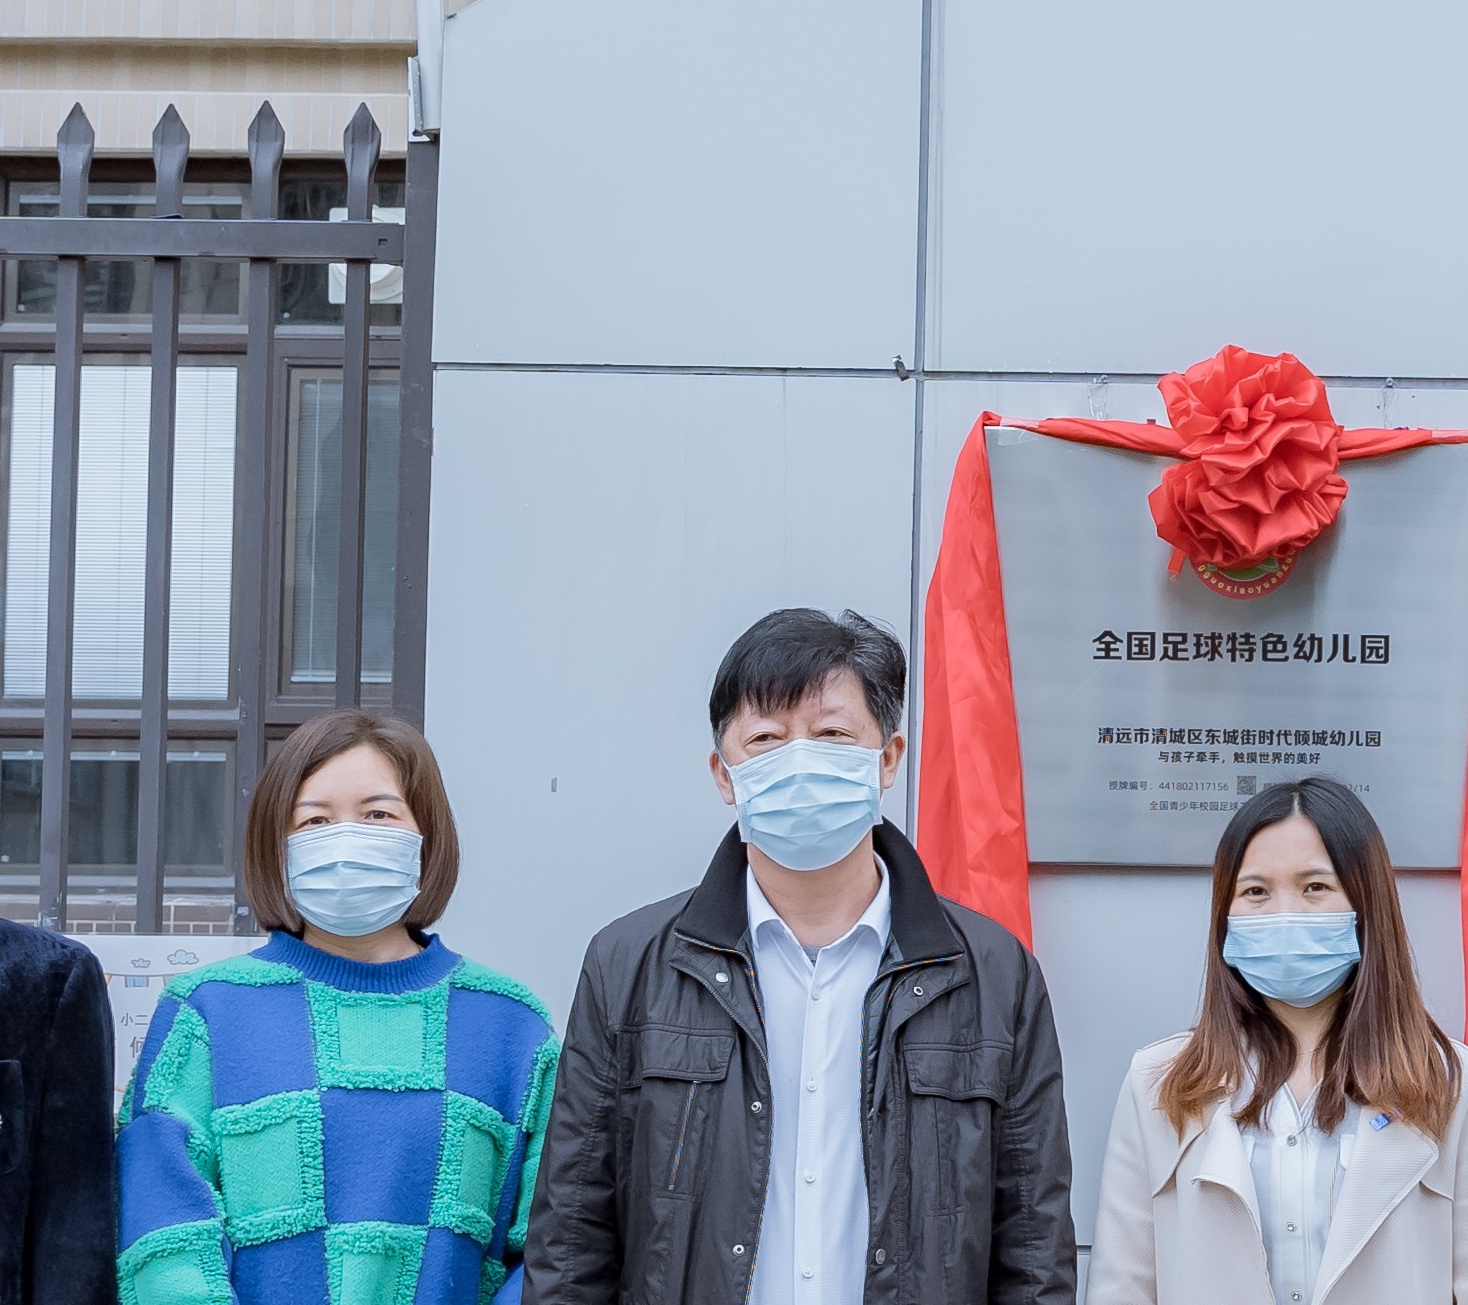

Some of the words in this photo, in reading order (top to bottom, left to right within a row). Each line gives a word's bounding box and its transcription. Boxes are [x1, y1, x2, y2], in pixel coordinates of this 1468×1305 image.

[1091, 630, 1391, 665] 全国足球特色幼儿园
[1097, 726, 1382, 748] 清远市清城区东城街时代倾城幼儿园
[1157, 750, 1322, 765] 与孩子牵手，触摸世界的美好
[1148, 800, 1246, 812] 全国青少年校园足球
